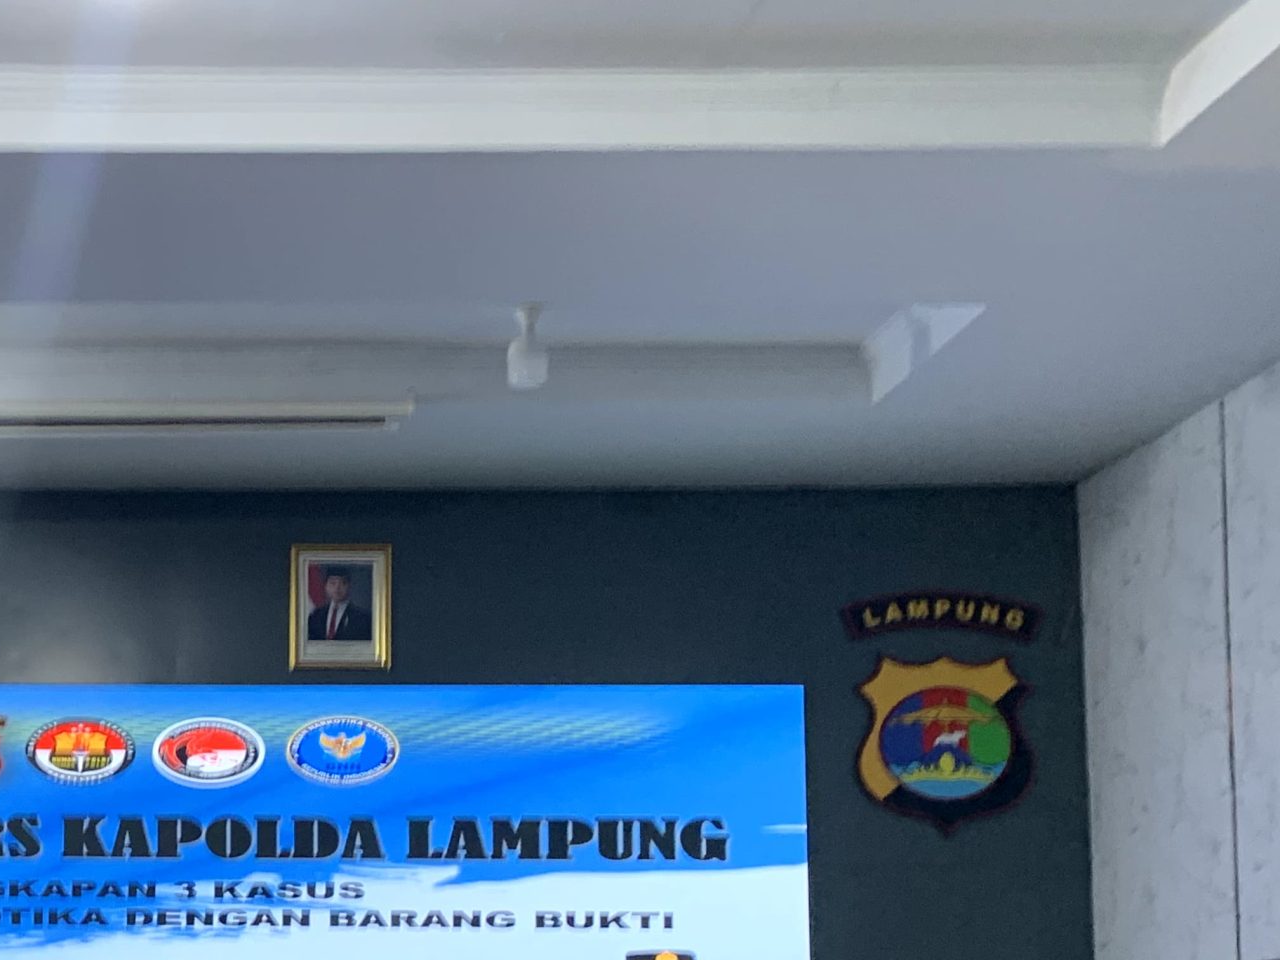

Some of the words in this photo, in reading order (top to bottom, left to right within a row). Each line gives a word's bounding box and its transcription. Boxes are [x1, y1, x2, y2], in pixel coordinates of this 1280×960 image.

[862, 599, 1025, 631] LAMPUNG
[61, 813, 385, 861] KAPOLDA
[405, 814, 730, 862] LAMPUNG
[174, 880, 198, 900] 3
[214, 880, 366, 901] KASUS
[126, 907, 310, 928] DENGAN
[329, 908, 516, 929] BARANG
[535, 910, 675, 930] BUKTI
